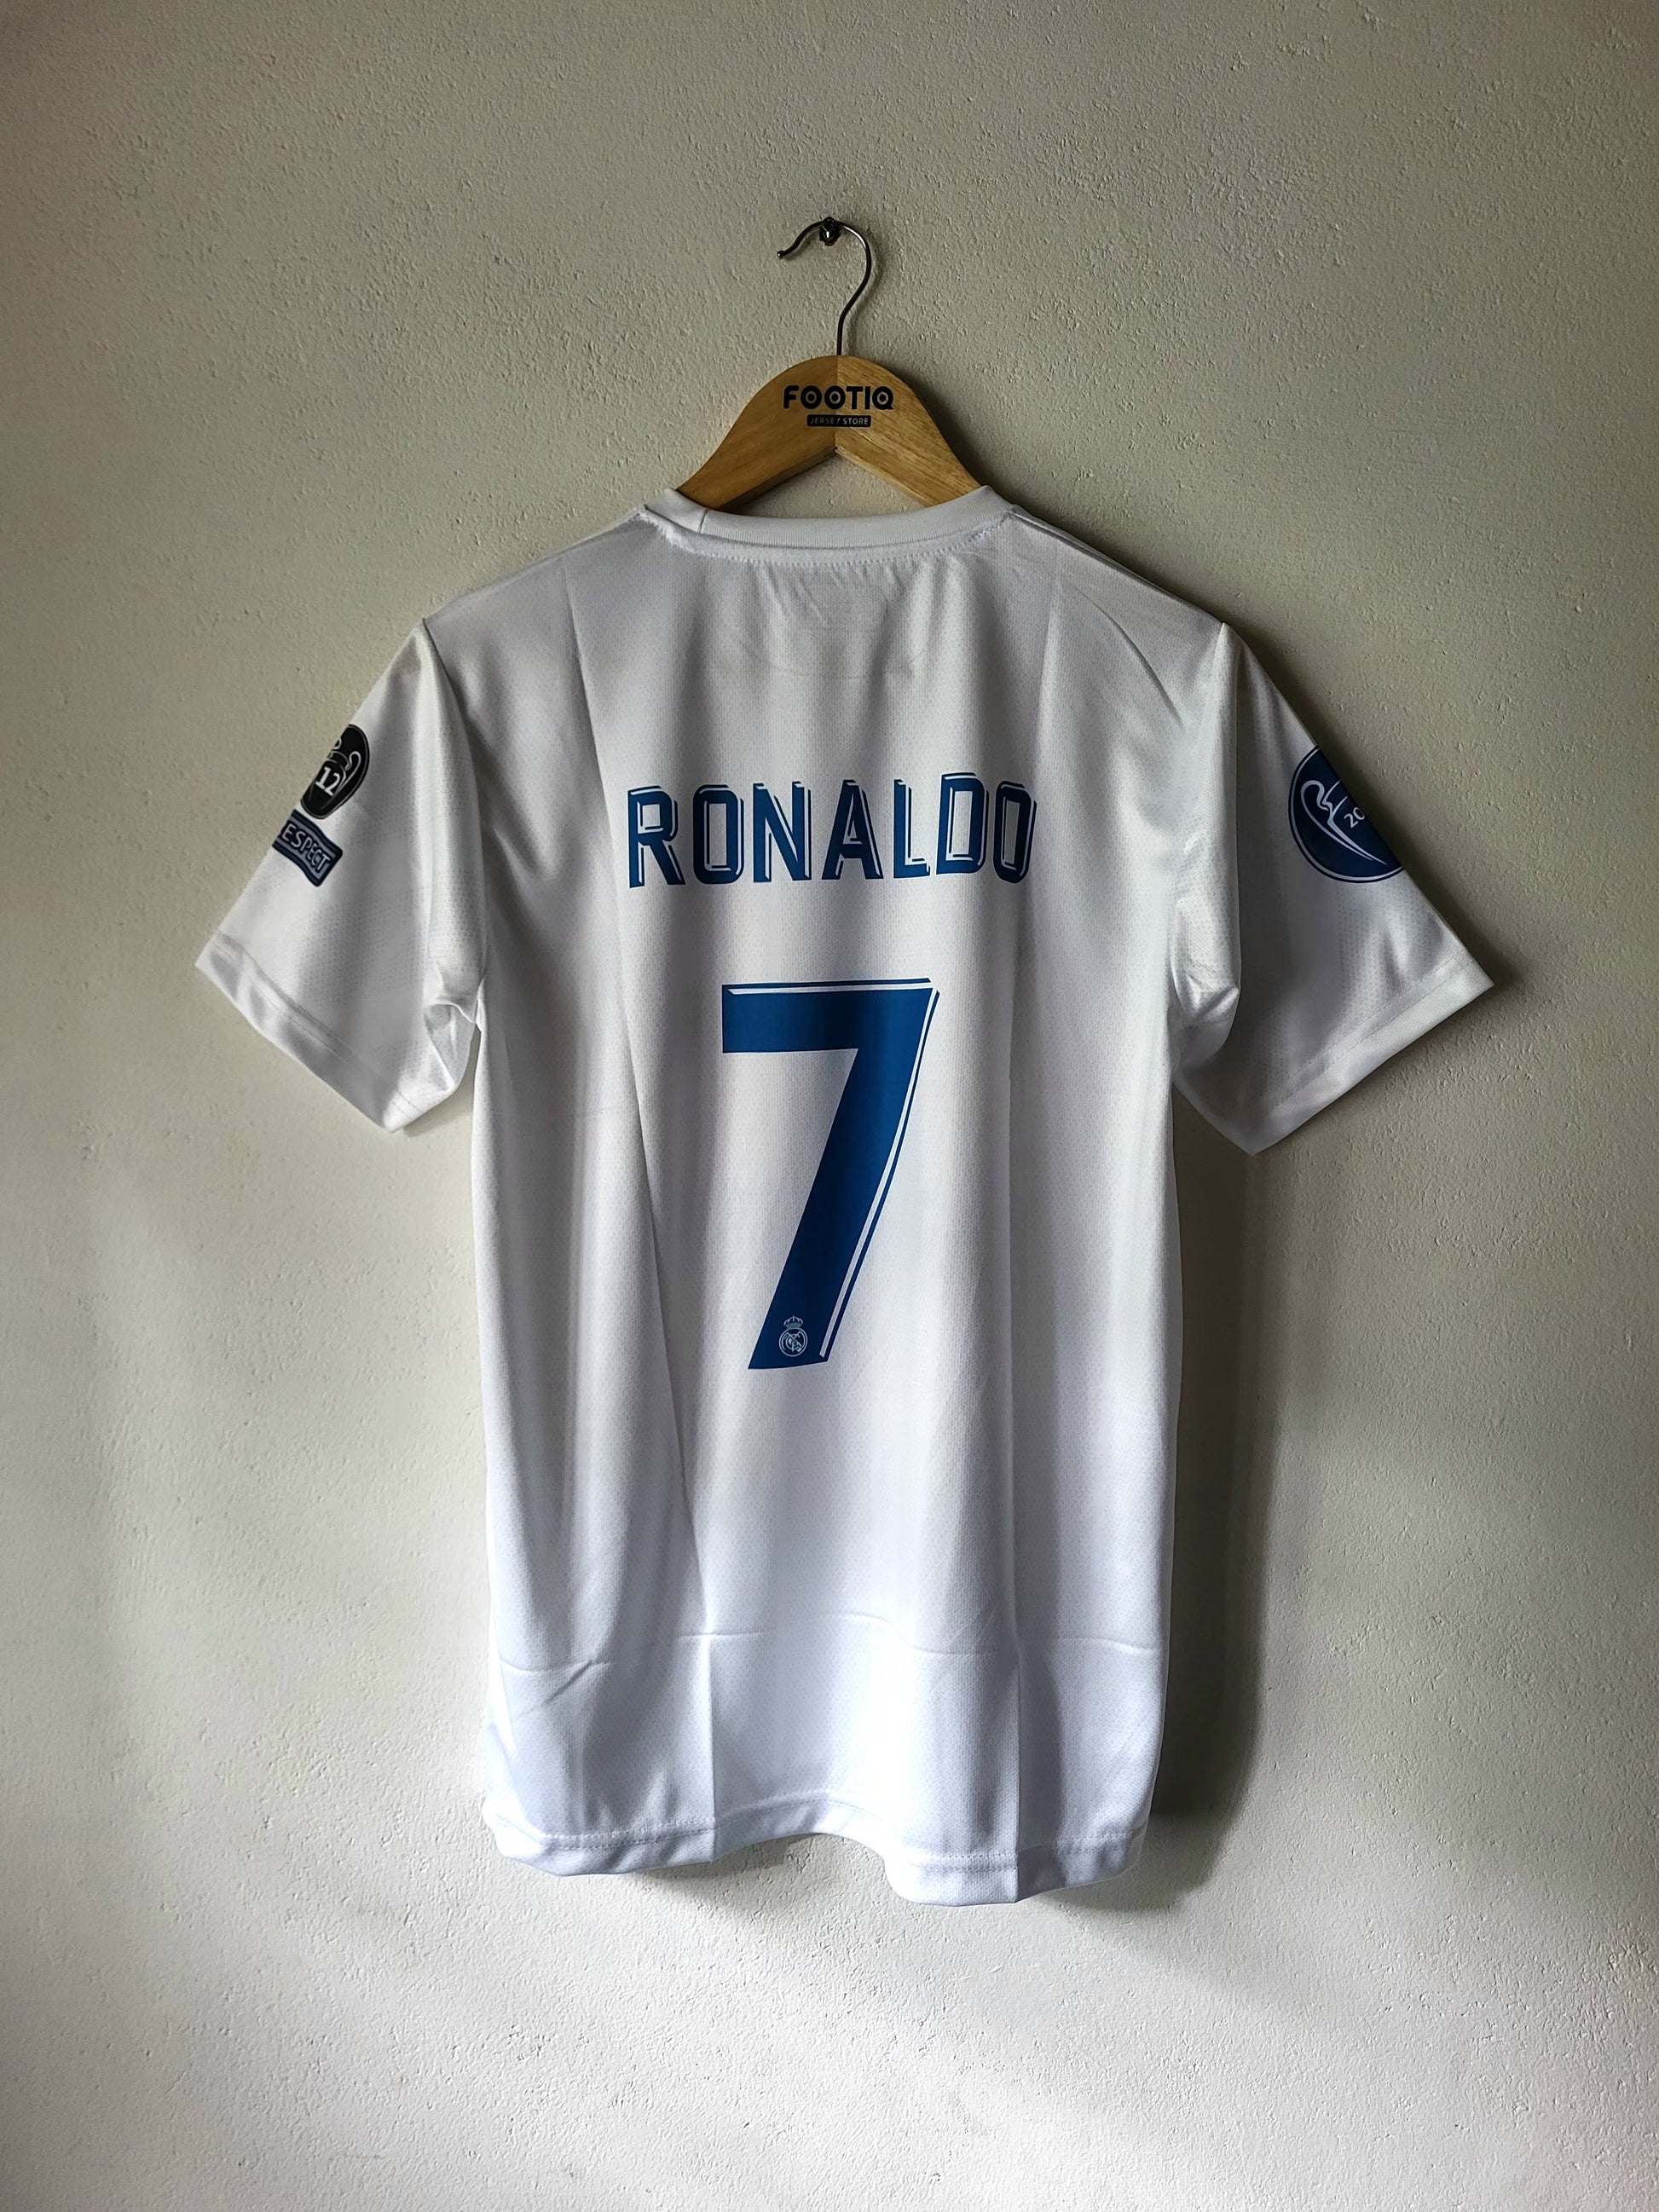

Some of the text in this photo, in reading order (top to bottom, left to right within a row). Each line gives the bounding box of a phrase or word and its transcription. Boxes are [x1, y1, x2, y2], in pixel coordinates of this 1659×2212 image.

[783, 384, 893, 411] FOOTIQ
[810, 416, 869, 425] JERSEY STORE
[315, 766, 341, 796] 12
[280, 822, 332, 871] ESPECT
[627, 772, 1038, 889] RONALDO
[722, 978, 940, 1370] 7
